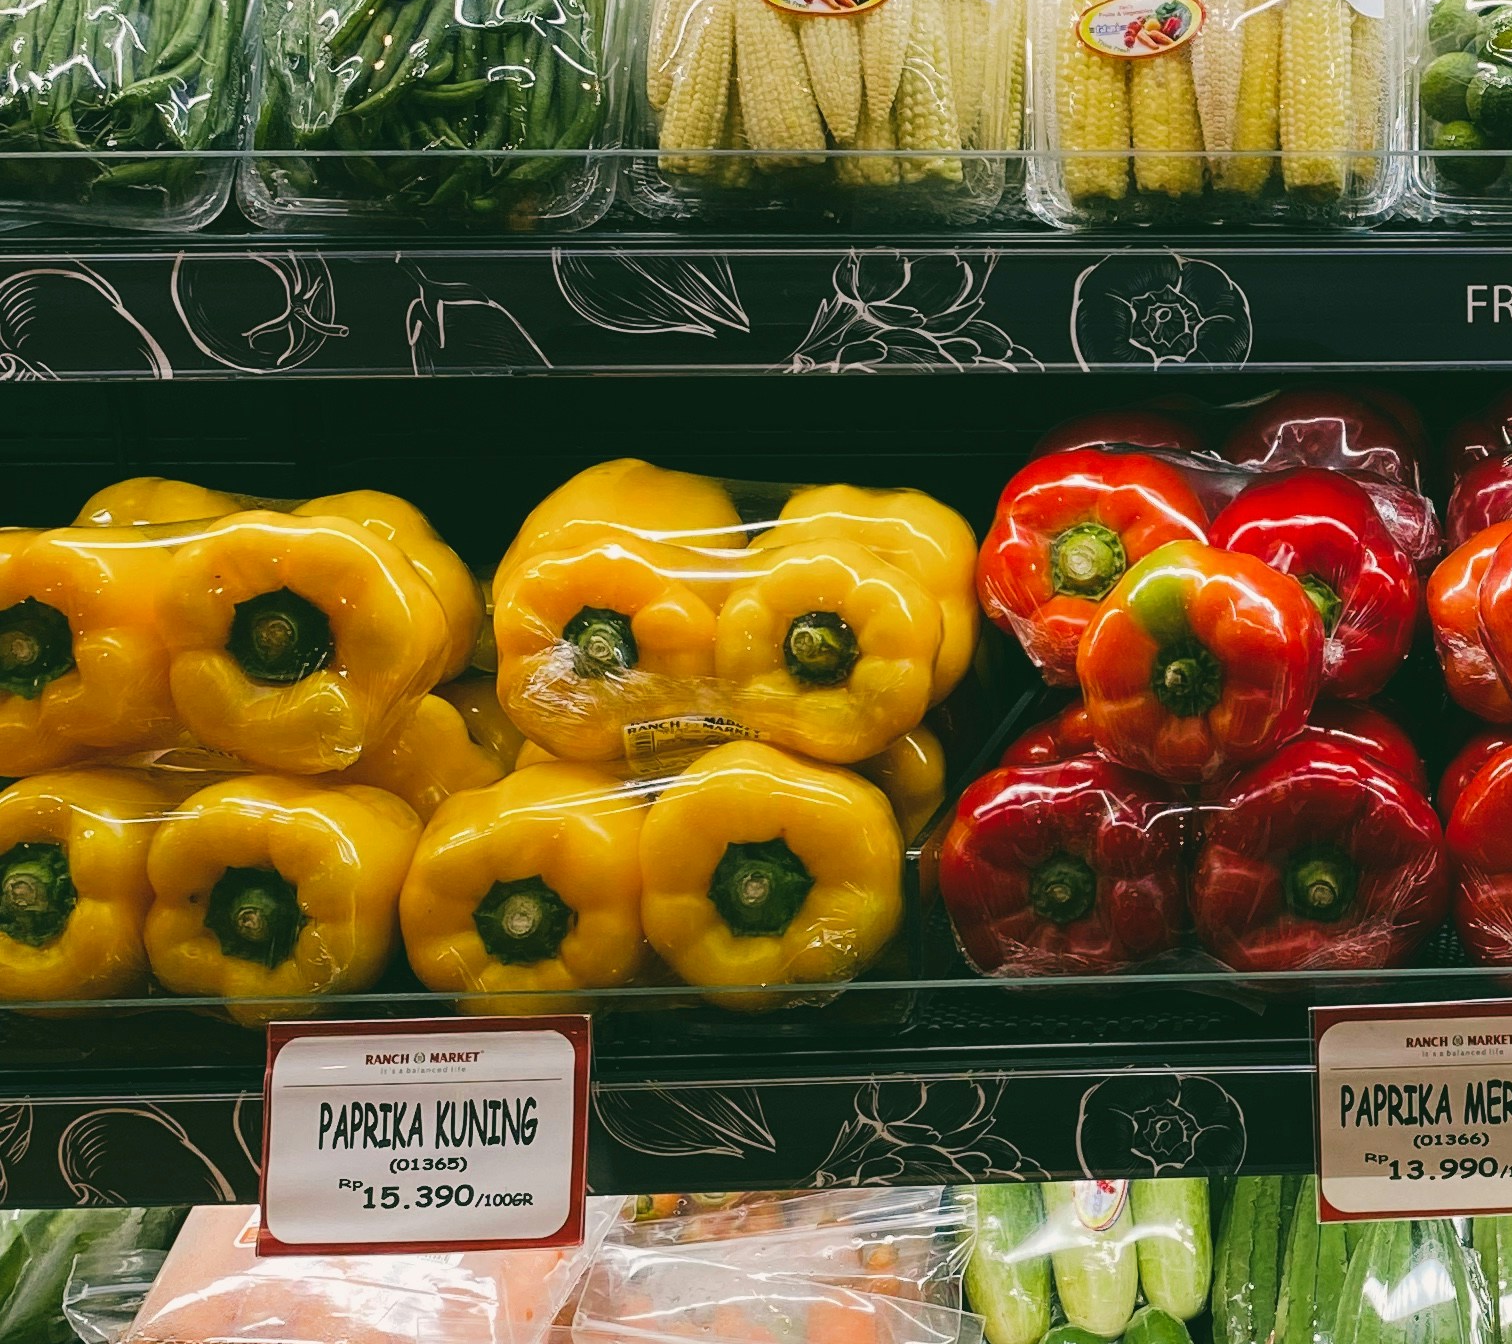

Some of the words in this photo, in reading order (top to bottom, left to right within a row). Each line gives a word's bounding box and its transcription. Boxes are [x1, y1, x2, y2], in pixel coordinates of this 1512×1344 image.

[1406, 1036, 1448, 1048] RANCH
[365, 1053, 410, 1065] RANCH
[429, 1051, 480, 1064] MARKET
[1446, 1049, 1487, 1057] balanced
[406, 1066, 448, 1074] balanced
[1340, 1083, 1453, 1129] PAPRIKA
[318, 1101, 424, 1150] PAPRIKA
[435, 1096, 539, 1150] KUNING
[1413, 1132, 1490, 1148] (01366)
[389, 1156, 468, 1173] (01365)
[1388, 1156, 1499, 1181] 13.990
[338, 1178, 364, 1192] Rp
[362, 1184, 475, 1209] 15.390
[474, 1193, 534, 1208] /100GR
